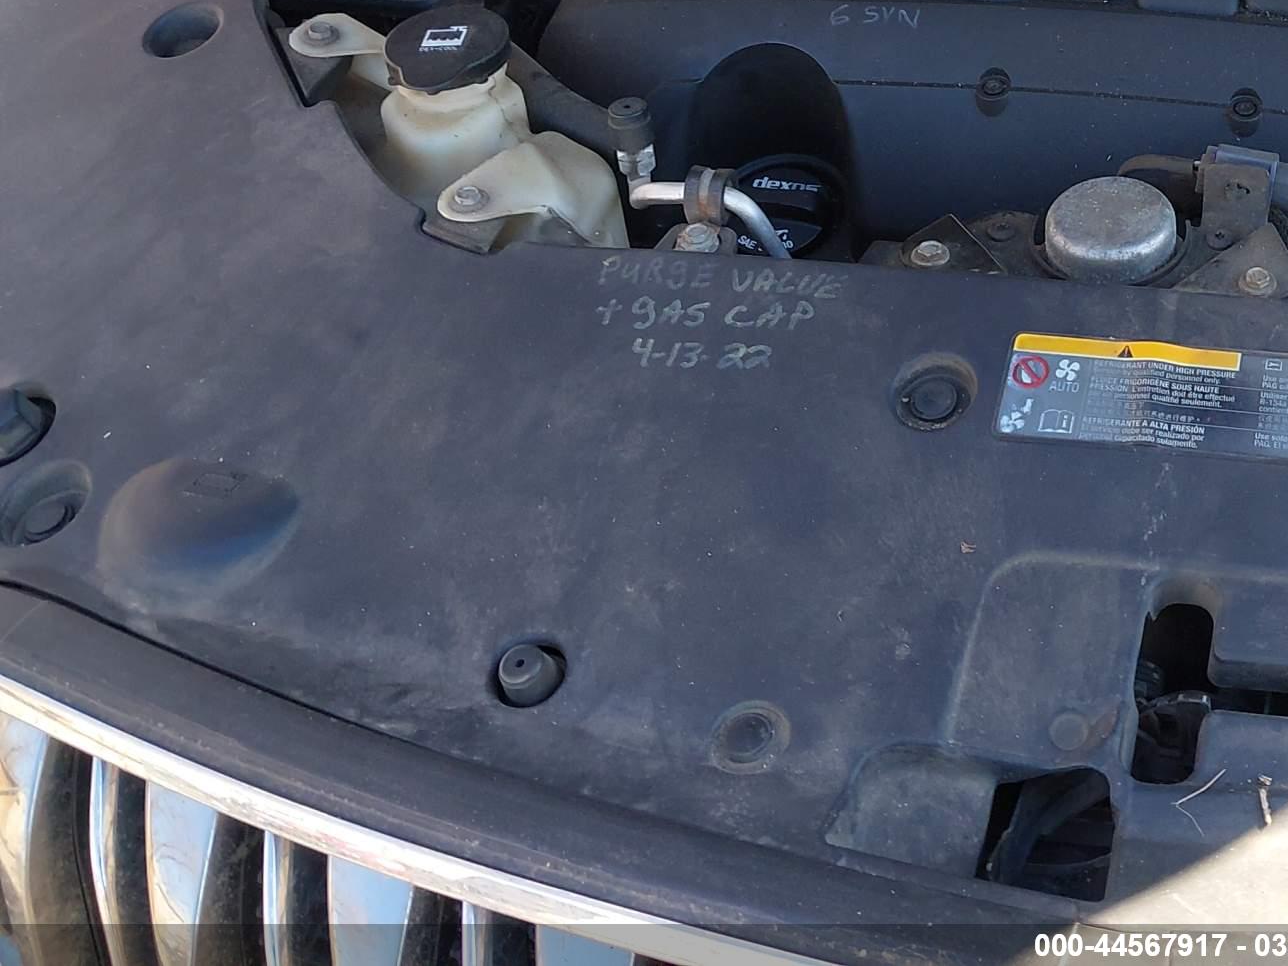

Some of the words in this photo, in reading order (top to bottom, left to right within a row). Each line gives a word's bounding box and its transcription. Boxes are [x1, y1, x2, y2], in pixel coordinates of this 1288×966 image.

[737, 235, 757, 249] SAE
[724, 300, 816, 331] CAP
[1148, 361, 1175, 372] UNDER
[1175, 366, 1195, 375] HIGH
[1196, 368, 1236, 379] PRESSURE
[1262, 374, 1278, 382] Use
[1049, 381, 1080, 393] AUTO
[1171, 383, 1192, 392] SOUS
[1193, 384, 1220, 394] HAUTE
[1261, 381, 1278, 390] PAG
[1181, 397, 1223, 408] seulement.
[1149, 420, 1169, 431] ALTA
[1170, 423, 1205, 435] PRESIÓN
[1141, 428, 1154, 436] ser
[1155, 429, 1190, 441] realizado
[1191, 434, 1204, 443] por
[1255, 432, 1270, 440] Use
